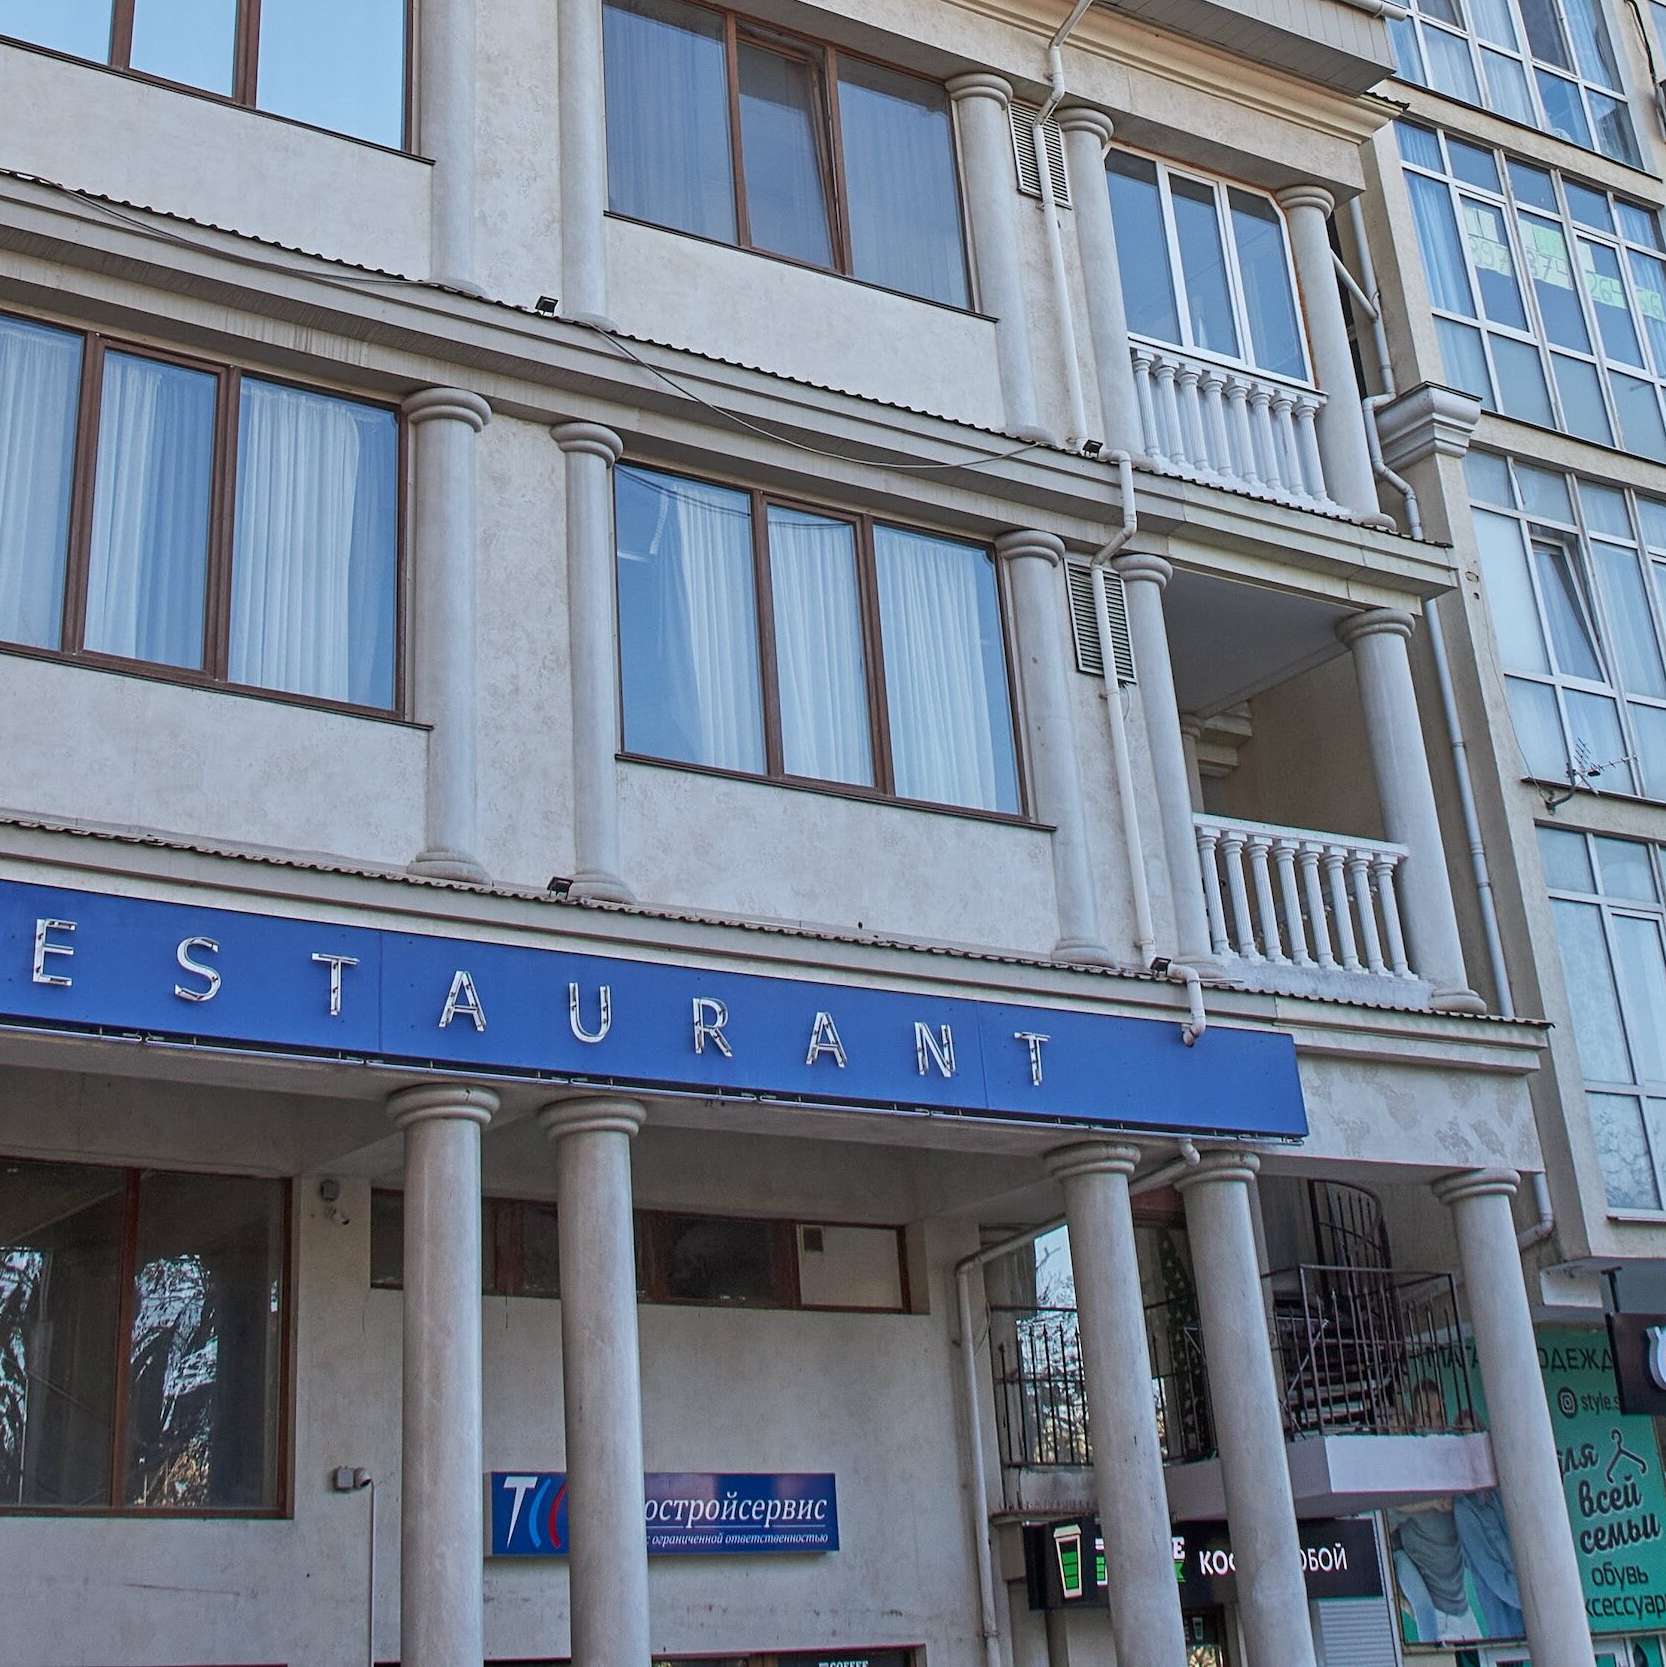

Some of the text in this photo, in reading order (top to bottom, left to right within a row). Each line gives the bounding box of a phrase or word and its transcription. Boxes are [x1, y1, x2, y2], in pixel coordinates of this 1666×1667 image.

[1578, 1474, 1643, 1519] всей
[652, 1532, 724, 1548] ограниченной
[725, 1532, 829, 1545] ответственностью
[1579, 1513, 1662, 1555] семьи
[1591, 1561, 1649, 1591] обувь
